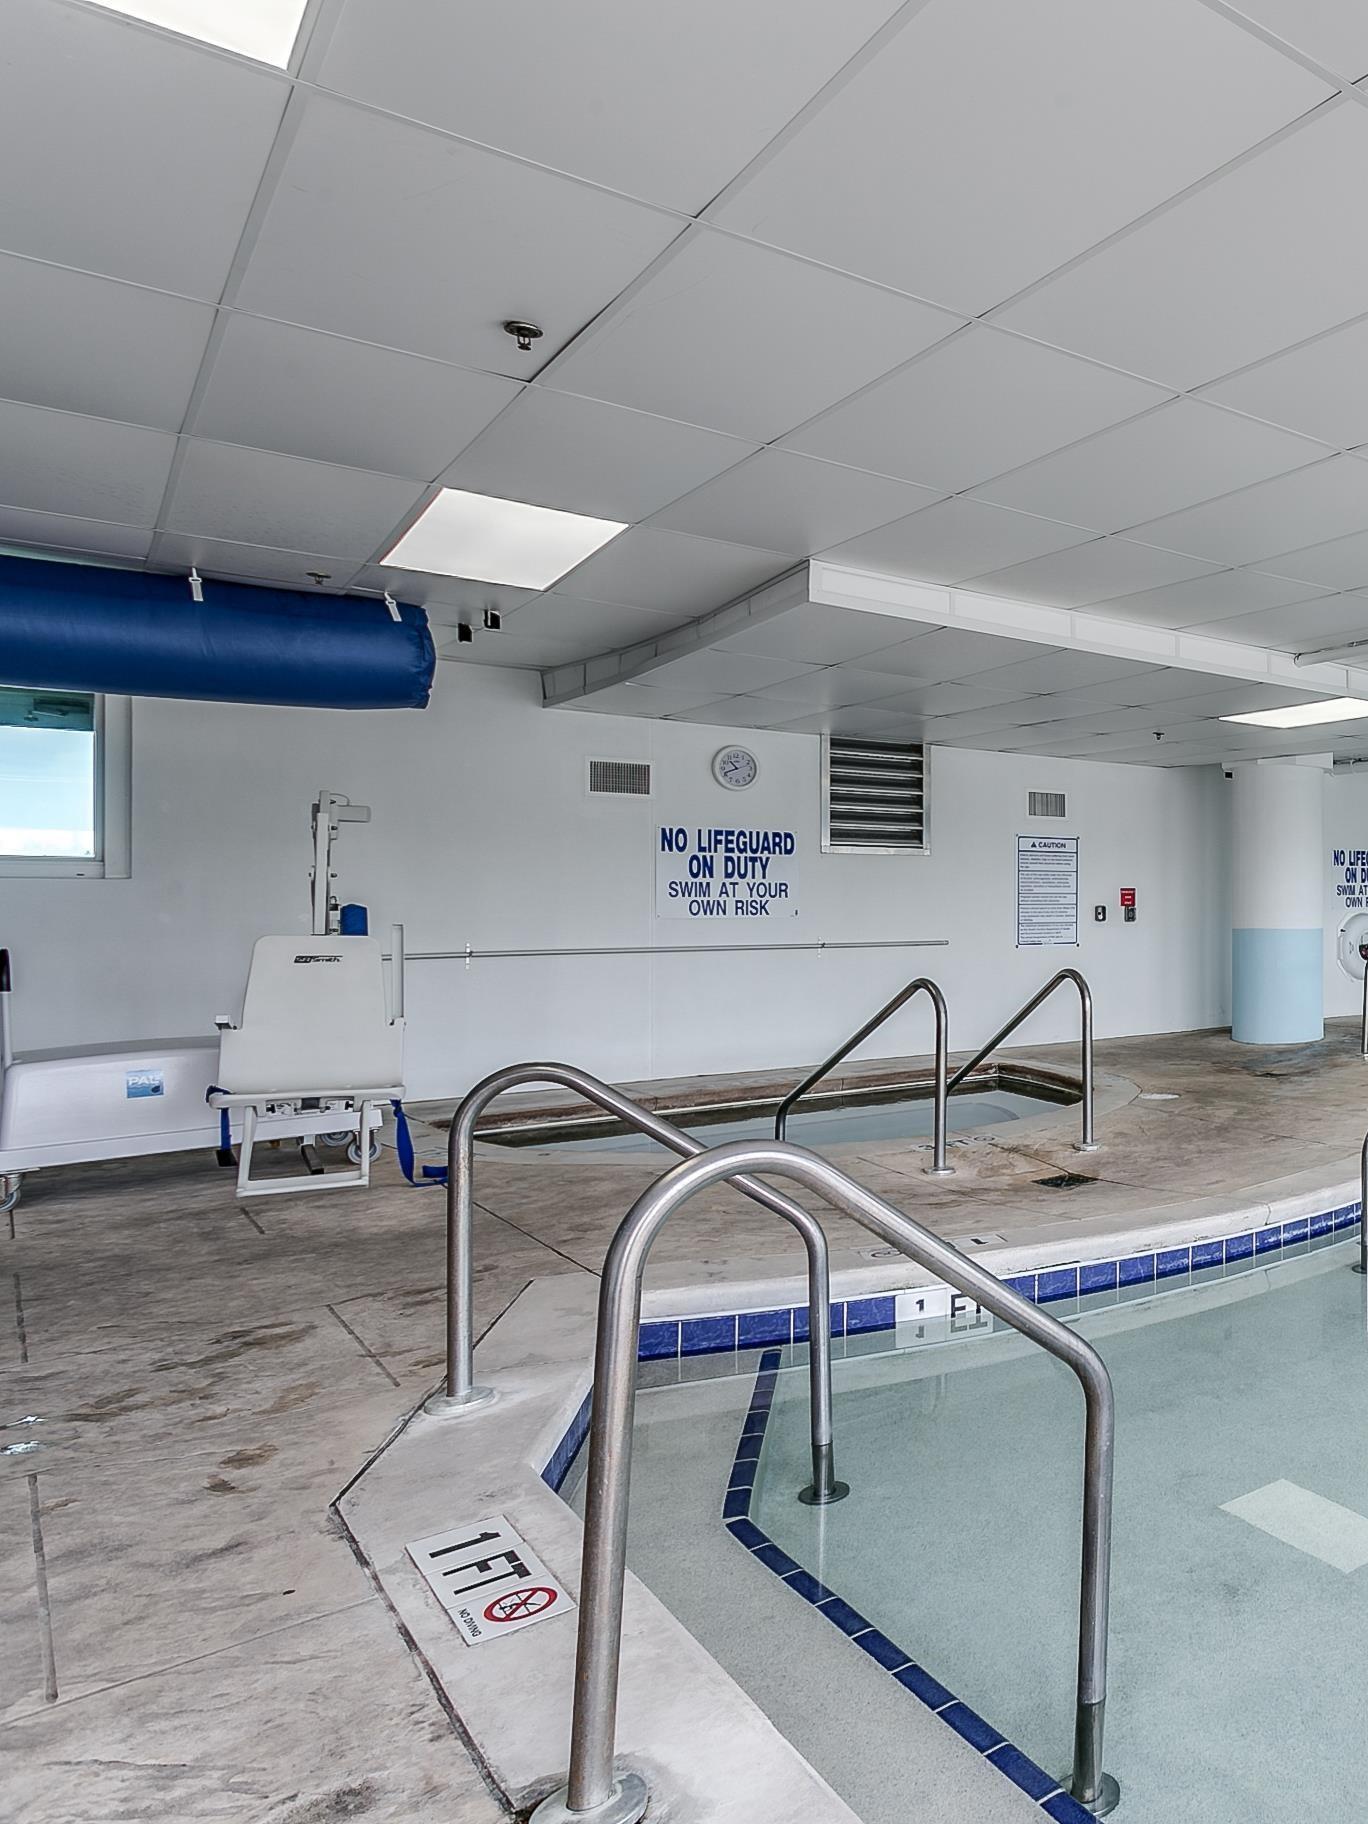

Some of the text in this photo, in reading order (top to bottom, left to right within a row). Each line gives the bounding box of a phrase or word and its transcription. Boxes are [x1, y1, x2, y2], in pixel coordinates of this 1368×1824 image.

[661, 828, 794, 855] NO LIFEGUARD
[1333, 850, 1345, 866] NO
[689, 854, 770, 879] ON DUTY
[1345, 867, 1357, 883] ON
[668, 881, 788, 898] SWIM AT YOUR
[1337, 885, 1355, 895] SWIM
[1359, 885, 1368, 895] AT
[689, 900, 770, 916] OWN RISK
[1345, 897, 1362, 907] OWN
[916, 1299, 924, 1311] 1
[428, 1532, 532, 1595] 1 FT
[457, 1608, 482, 1637] NO DIVING
